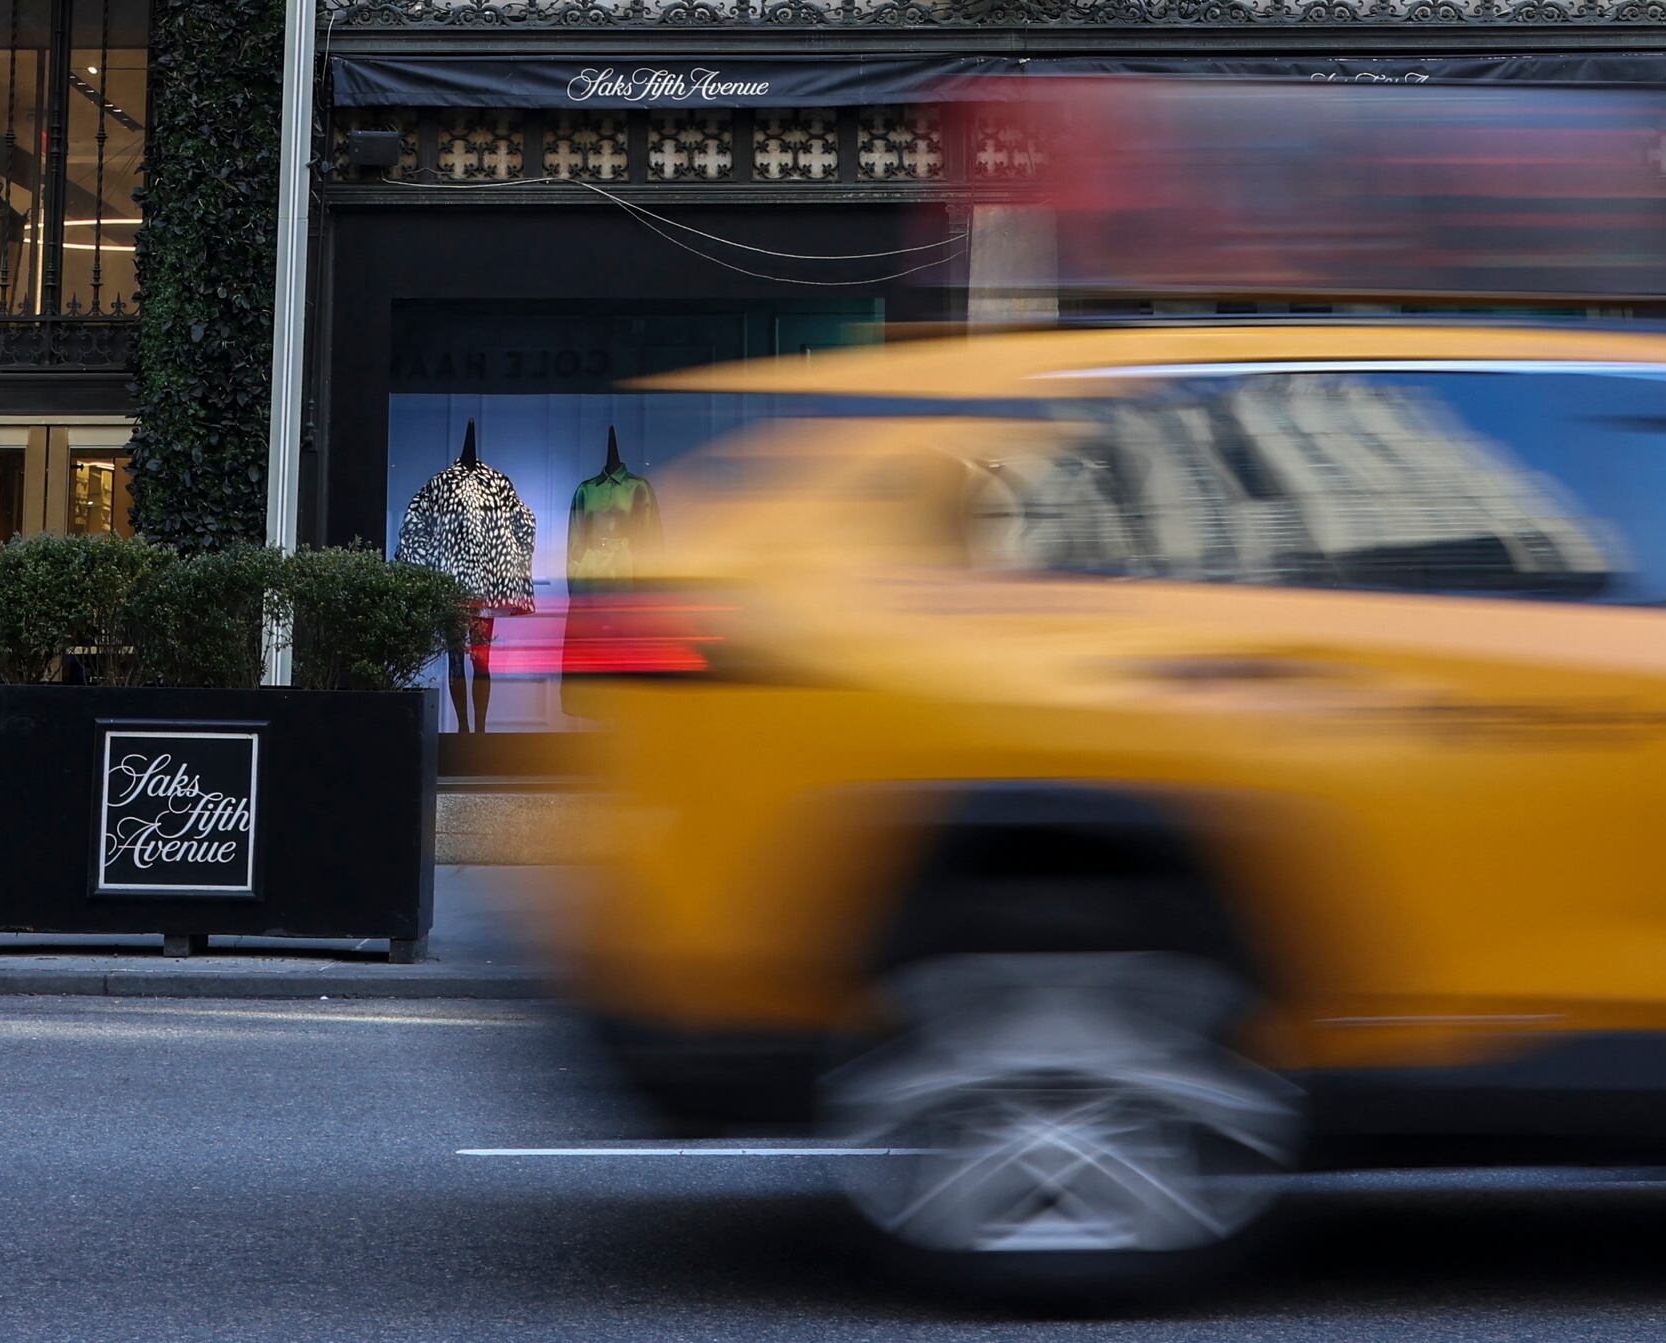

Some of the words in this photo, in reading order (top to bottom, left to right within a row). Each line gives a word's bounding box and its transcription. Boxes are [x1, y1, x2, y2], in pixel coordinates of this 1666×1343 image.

[567, 67, 633, 102] Saks
[624, 68, 686, 101] Fifth
[672, 67, 770, 101] Avenue
[107, 754, 201, 807] Saks
[155, 789, 250, 840] Fifth
[104, 816, 237, 869] Avenue
